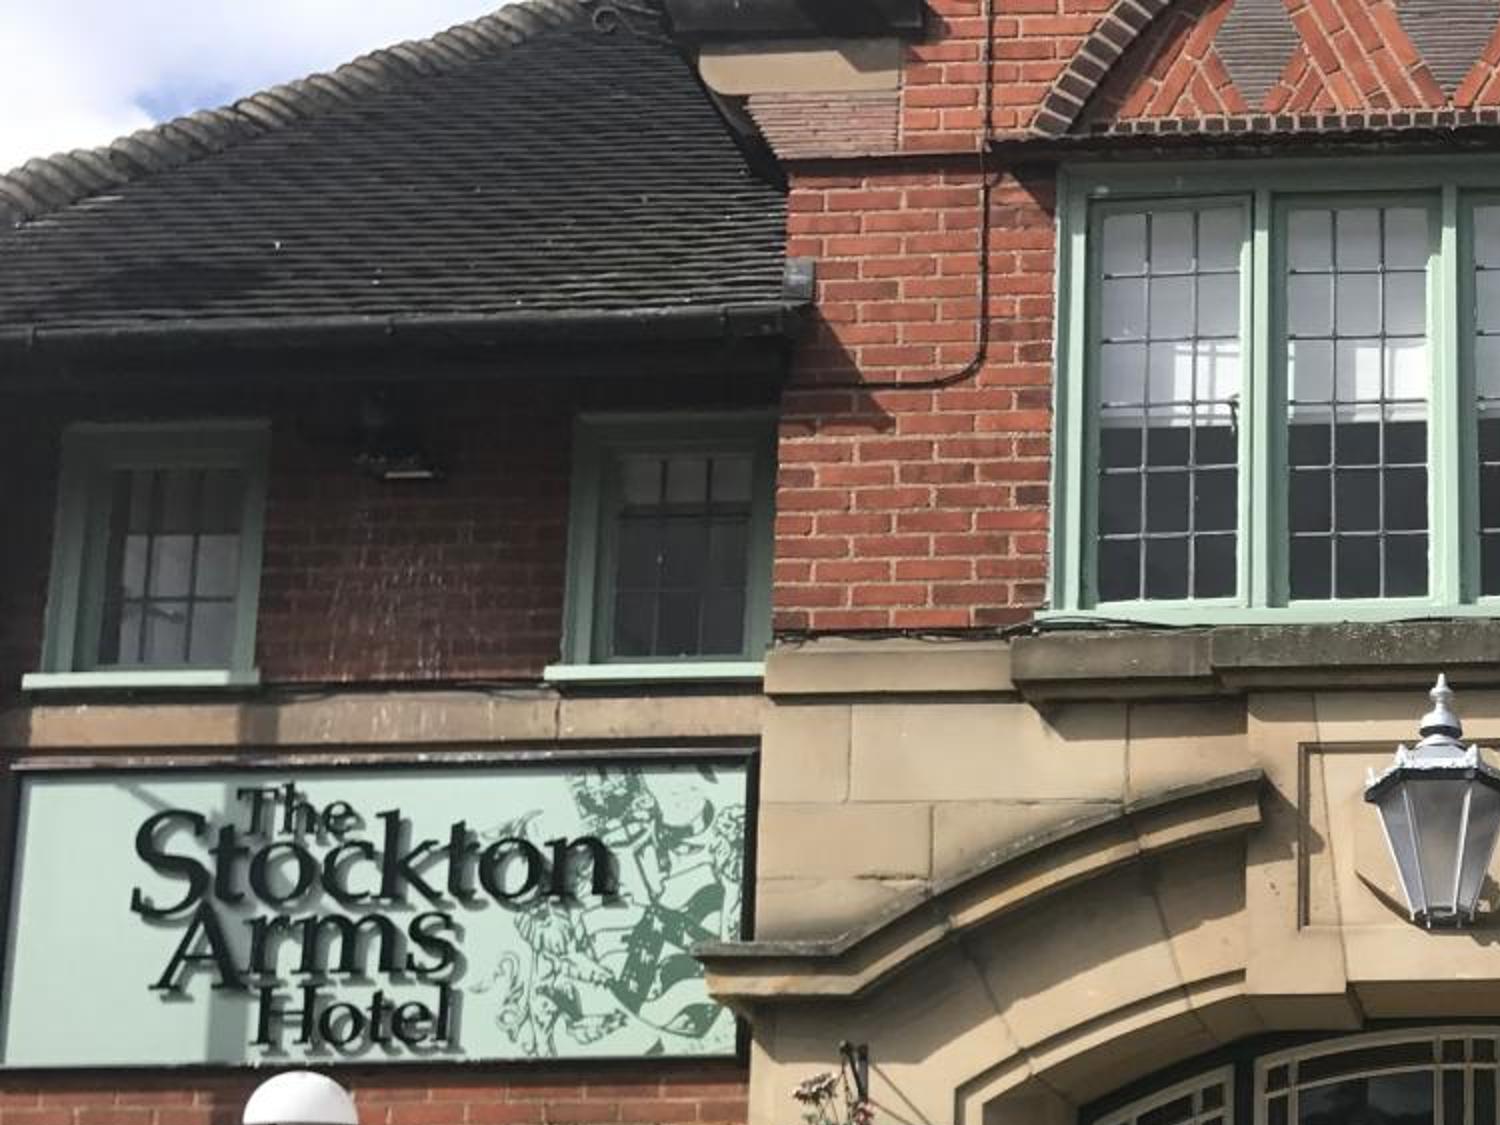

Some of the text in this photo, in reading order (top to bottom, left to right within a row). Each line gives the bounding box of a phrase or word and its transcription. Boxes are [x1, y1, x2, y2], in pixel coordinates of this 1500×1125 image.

[237, 782, 358, 838] The
[130, 810, 620, 916] Stockton
[148, 899, 457, 992] Arms
[250, 984, 455, 1046] Hotel
